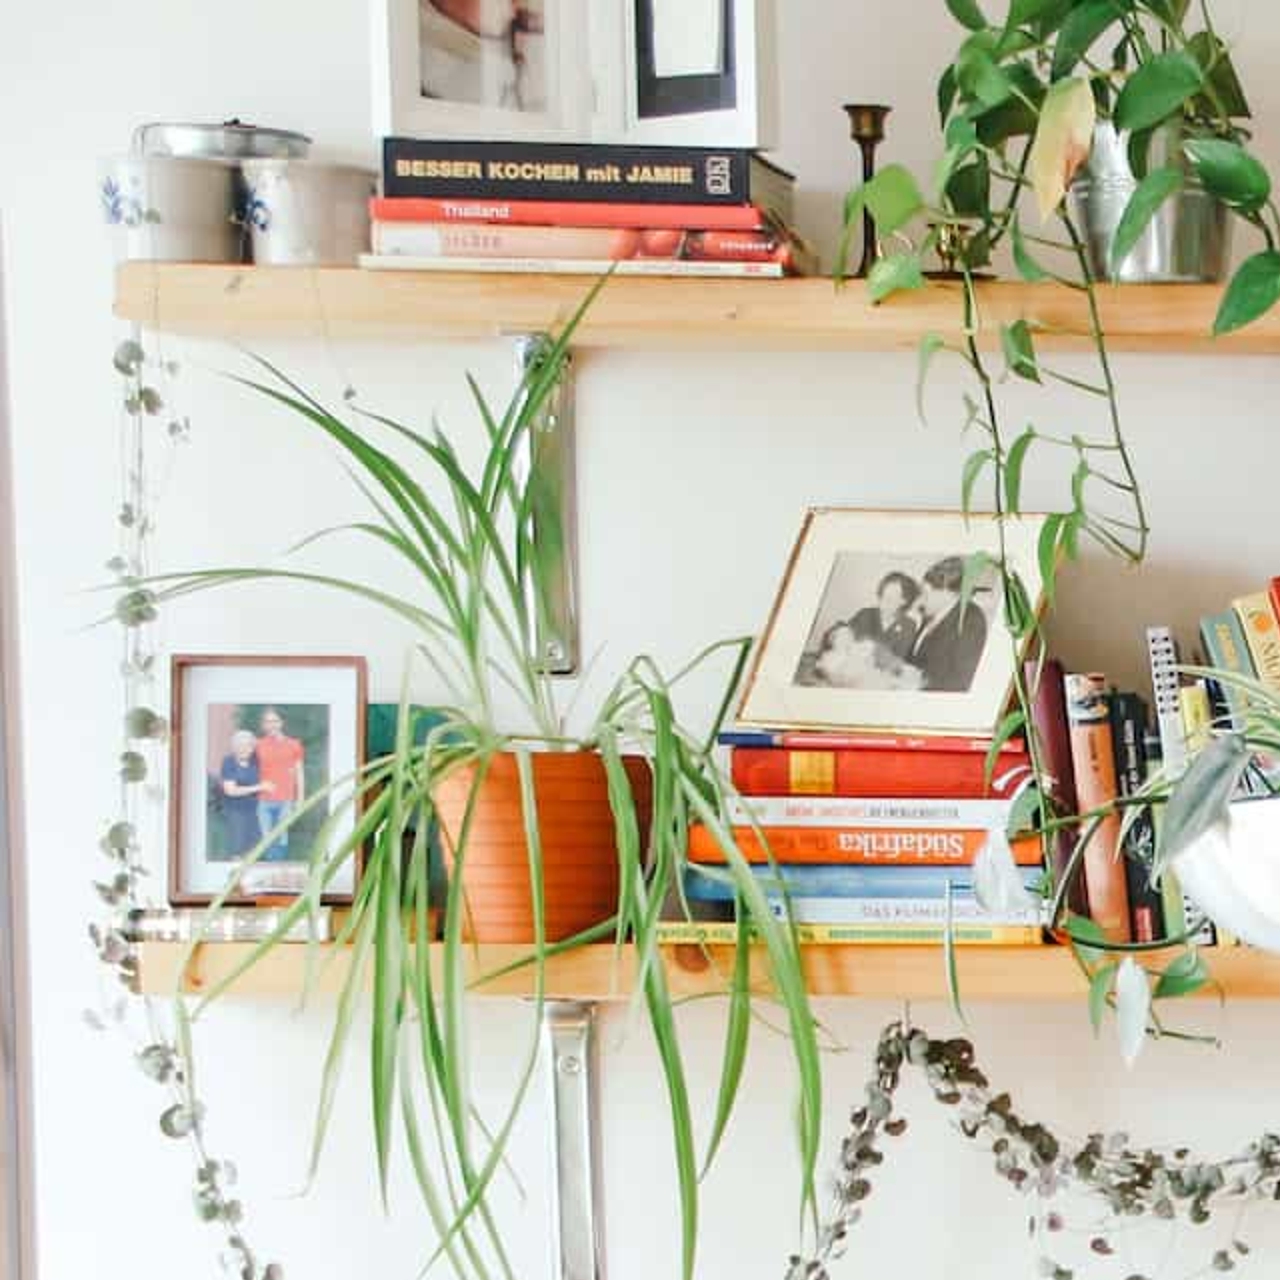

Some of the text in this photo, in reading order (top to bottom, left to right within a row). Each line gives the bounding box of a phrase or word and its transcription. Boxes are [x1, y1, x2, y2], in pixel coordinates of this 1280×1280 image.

[396, 159, 694, 184] BESSER KOCHEN mit JAMIE
[442, 203, 511, 219] Thailand
[838, 831, 964, 858] Südafrika
